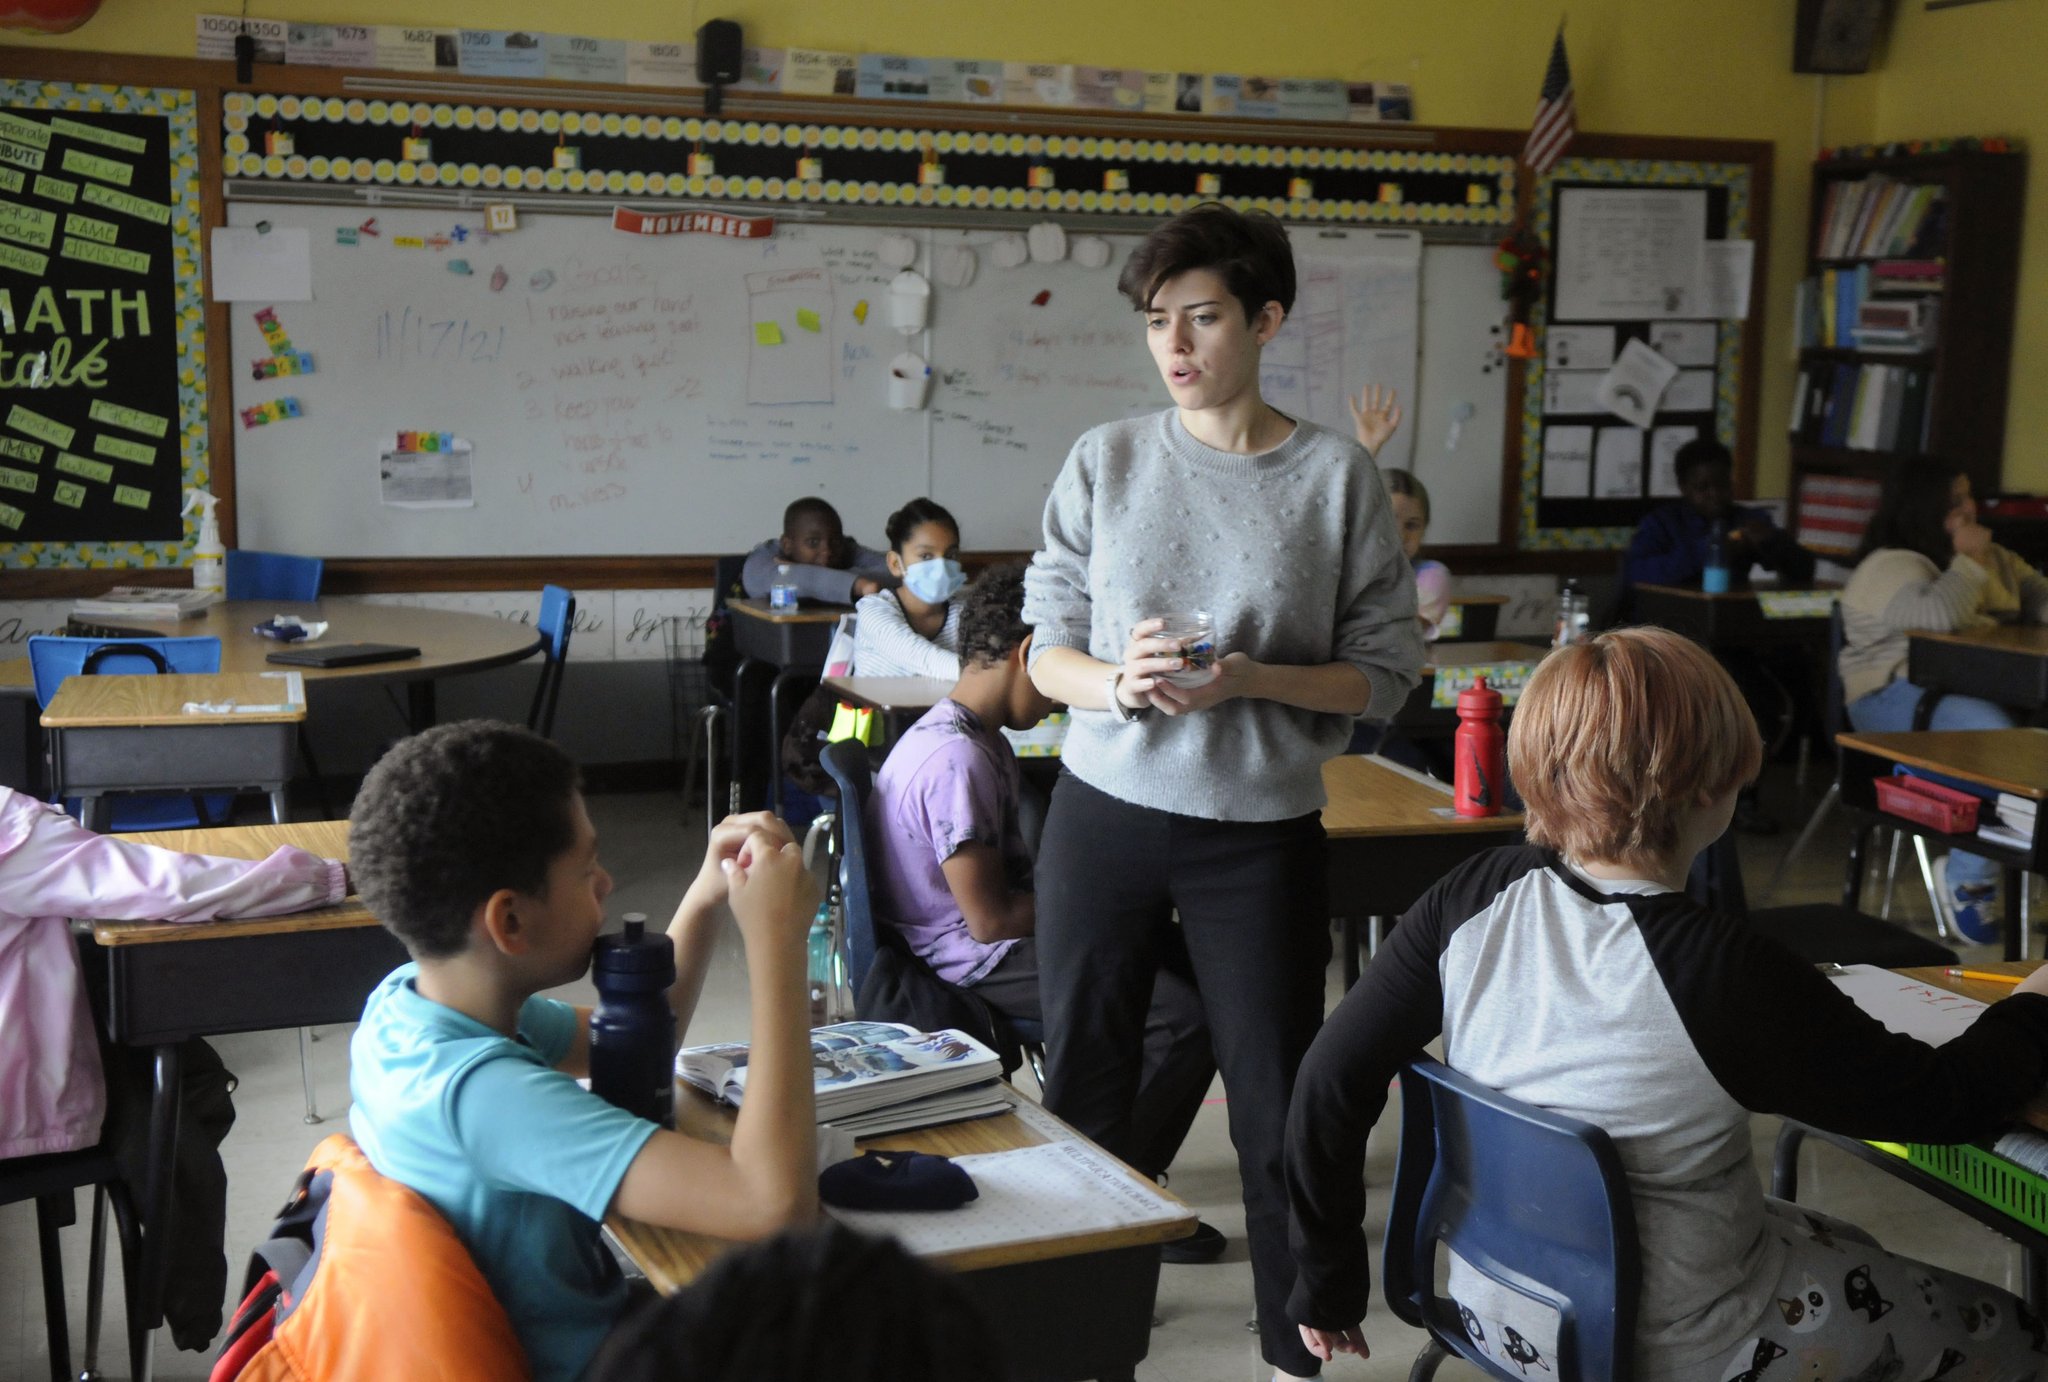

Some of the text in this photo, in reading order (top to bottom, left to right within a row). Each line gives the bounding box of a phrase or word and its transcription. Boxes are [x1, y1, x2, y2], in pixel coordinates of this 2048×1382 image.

[0, 142, 40, 167] IBUTE
[68, 214, 117, 241] SAME
[640, 213, 752, 238] NOVEMBER
